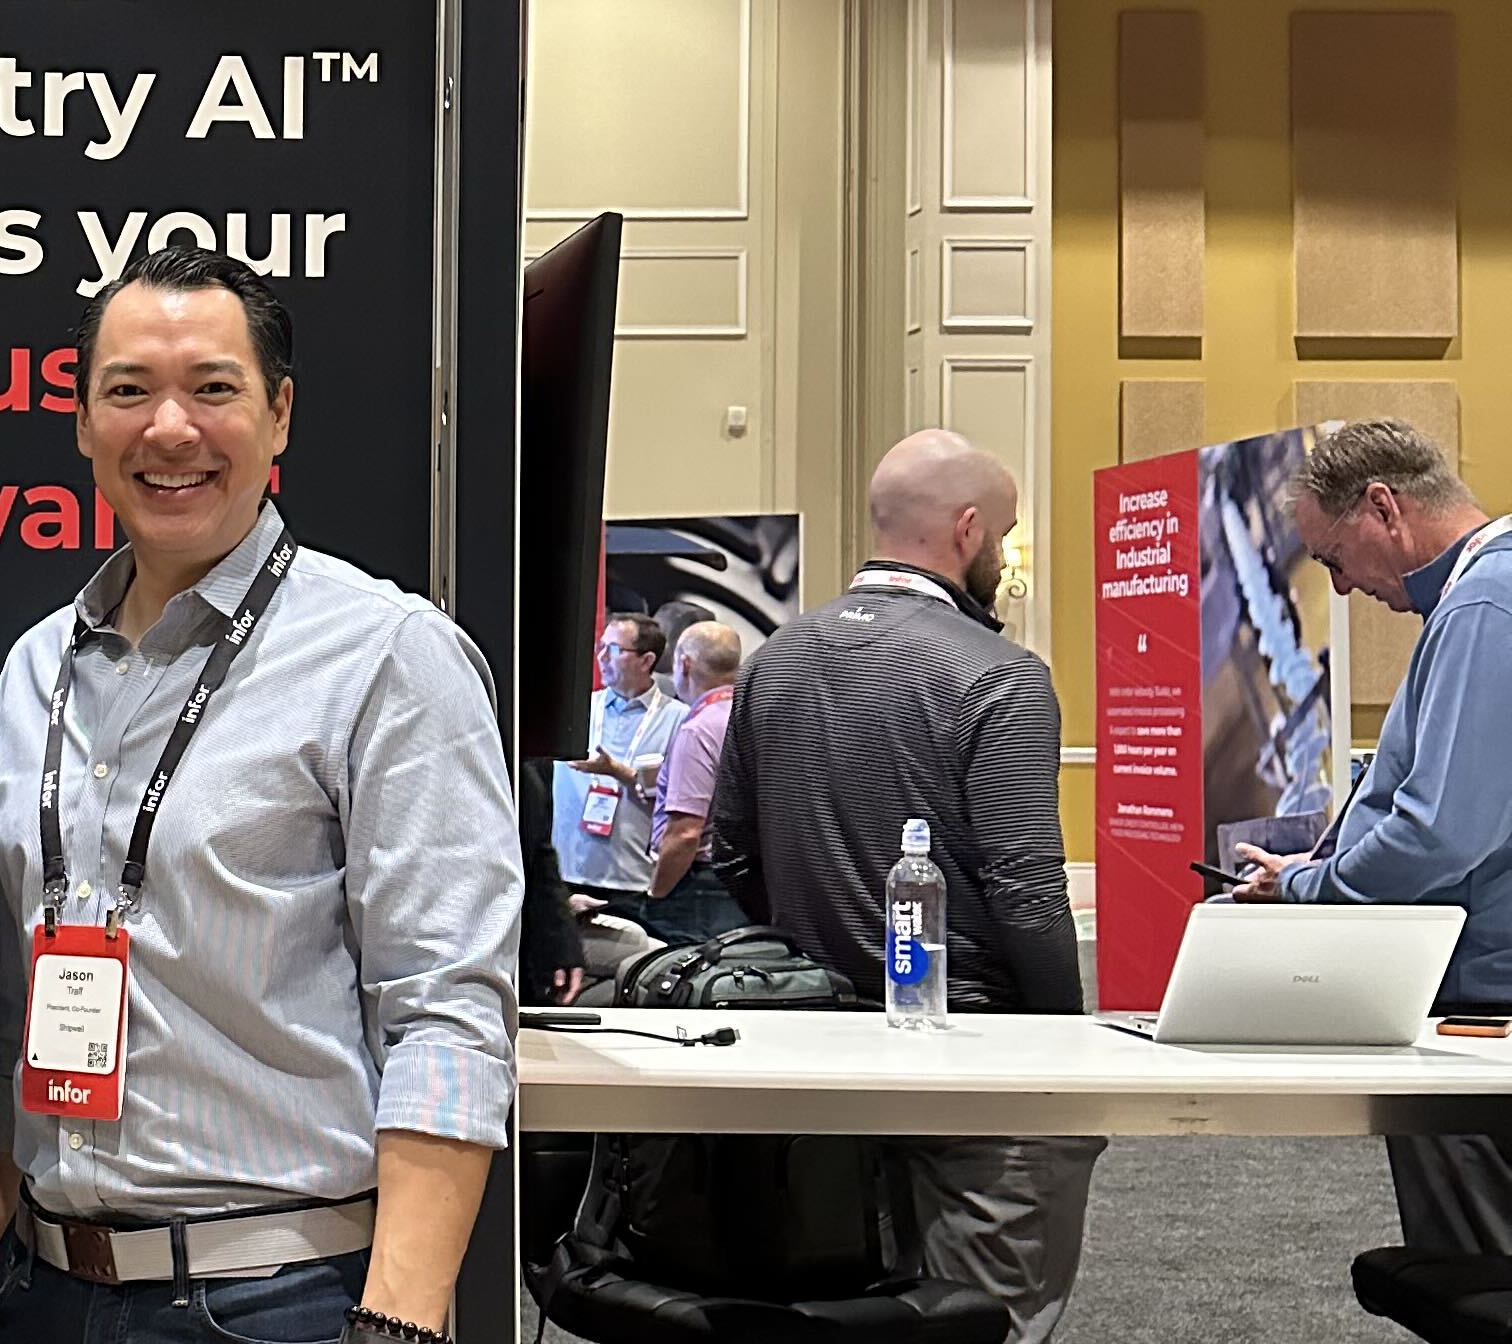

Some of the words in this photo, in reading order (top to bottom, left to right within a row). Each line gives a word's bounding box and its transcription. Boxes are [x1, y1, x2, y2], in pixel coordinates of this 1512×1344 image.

[76, 212, 345, 298] your
[1119, 489, 1168, 514] Increase
[1109, 517, 1164, 543] efficiency
[1166, 511, 1178, 535] in
[266, 542, 294, 578] infor
[1116, 542, 1171, 570] Industrial
[1102, 569, 1188, 599] manufacturing
[225, 609, 255, 646] infor
[51, 688, 64, 726] infor
[181, 683, 210, 724] infor
[42, 769, 57, 809] infor
[142, 770, 168, 813] infor
[912, 901, 923, 936] water
[892, 900, 912, 975] smart
[58, 968, 94, 982] Jason
[1292, 975, 1320, 984] DELL
[48, 1078, 92, 1104] infor
